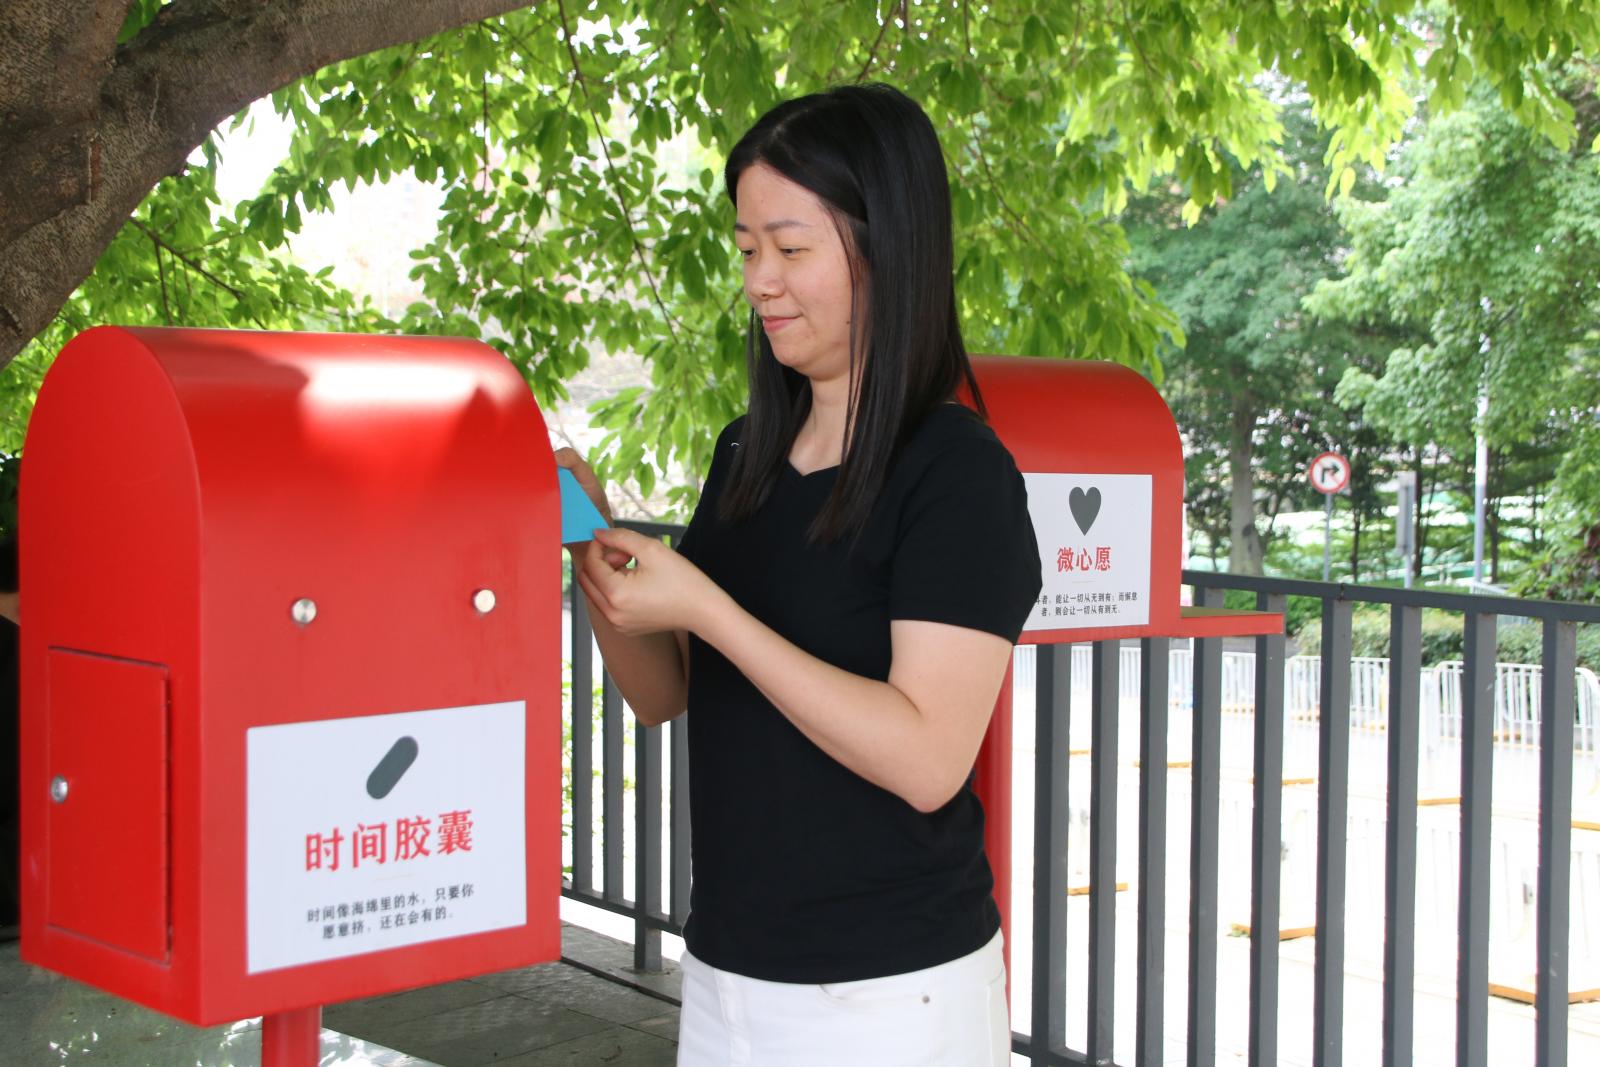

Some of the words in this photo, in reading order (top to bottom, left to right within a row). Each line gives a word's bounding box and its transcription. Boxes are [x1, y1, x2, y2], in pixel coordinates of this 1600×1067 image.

[1057, 546, 1111, 573] 微心愿
[305, 809, 474, 872] 时间胶囊
[307, 883, 475, 922] 时间像海绵里的水，只要你
